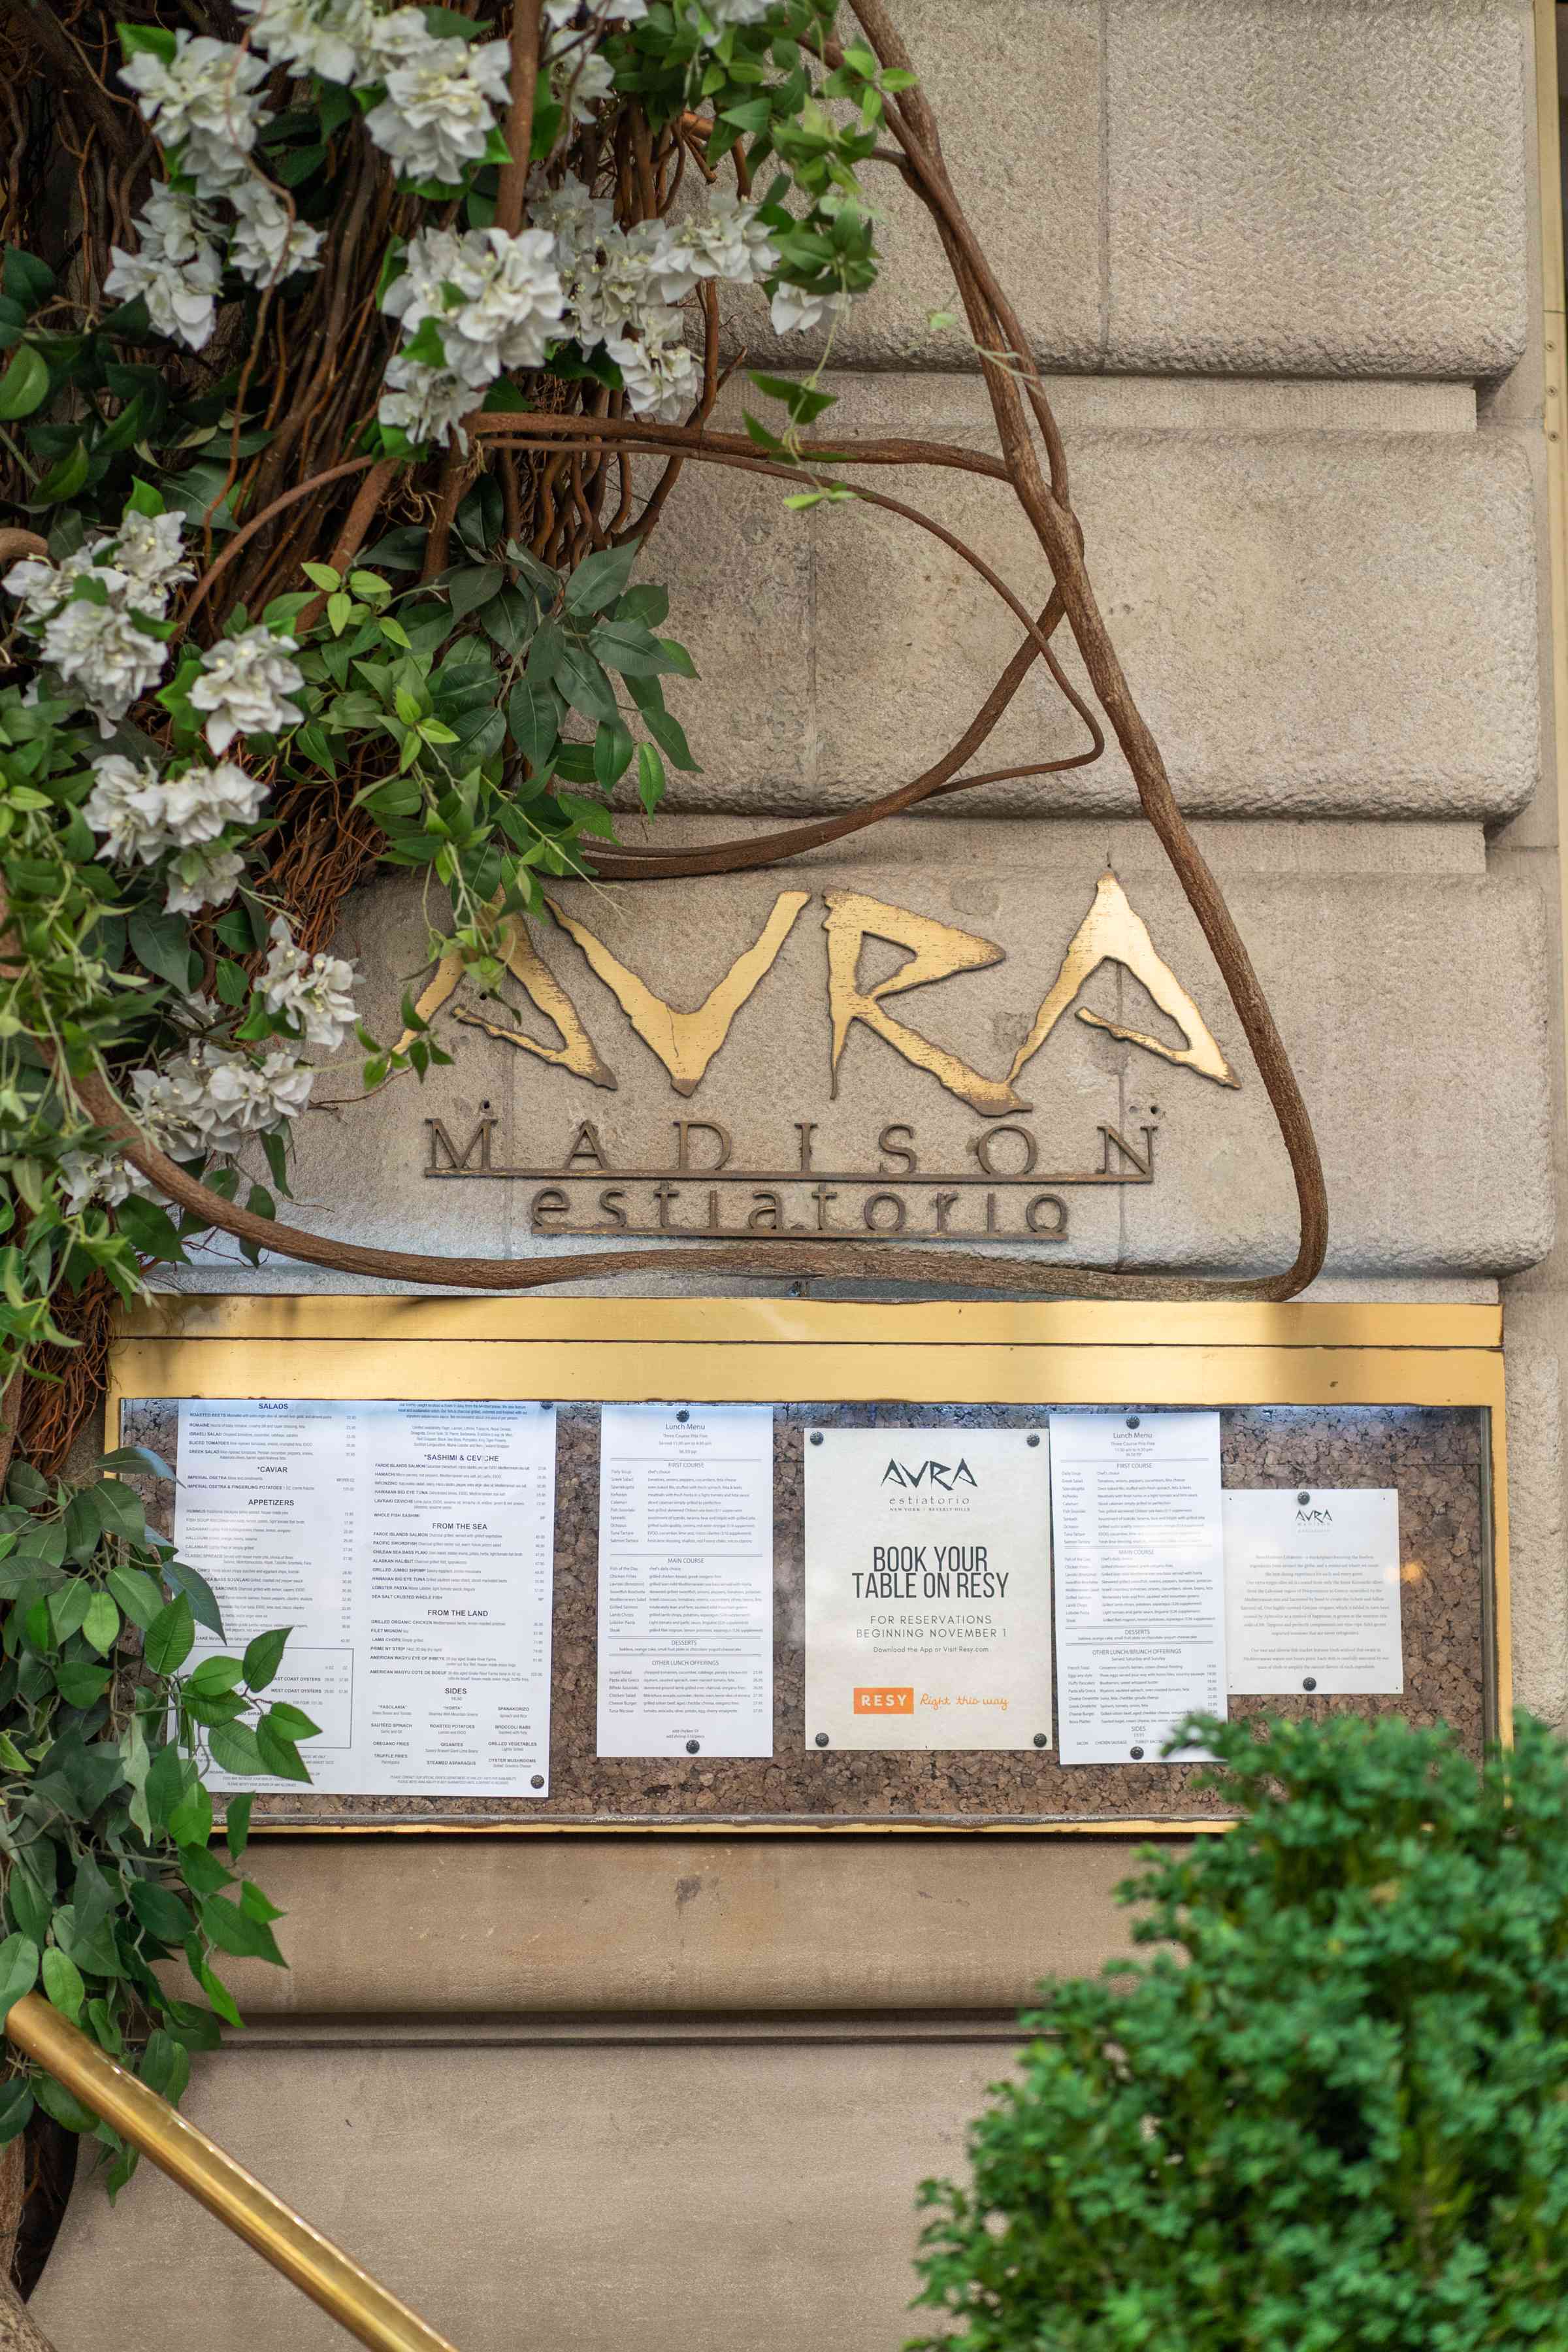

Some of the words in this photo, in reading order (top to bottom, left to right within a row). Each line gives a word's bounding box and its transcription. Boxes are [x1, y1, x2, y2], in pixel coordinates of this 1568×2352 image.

[372, 872, 1242, 1117] AVRA
[425, 1117, 1158, 1177] MADISON
[532, 1183, 1068, 1235] estiatorio
[666, 1422, 685, 1430] Lunch
[1113, 1431, 1132, 1439] Lunch
[881, 1458, 977, 1490] AVRA
[874, 1546, 927, 1571] BOOK
[934, 1546, 987, 1571] YOUR
[852, 1573, 916, 1597] TABLE
[924, 1573, 949, 1597] ON
[957, 1573, 1009, 1597] RESY
[857, 1629, 924, 1637] BEGINNING
[930, 1629, 996, 1637] NOVEMBER
[1004, 1629, 1006, 1637] 1
[860, 1695, 907, 1706] RESY
[983, 1693, 1009, 1710] way
